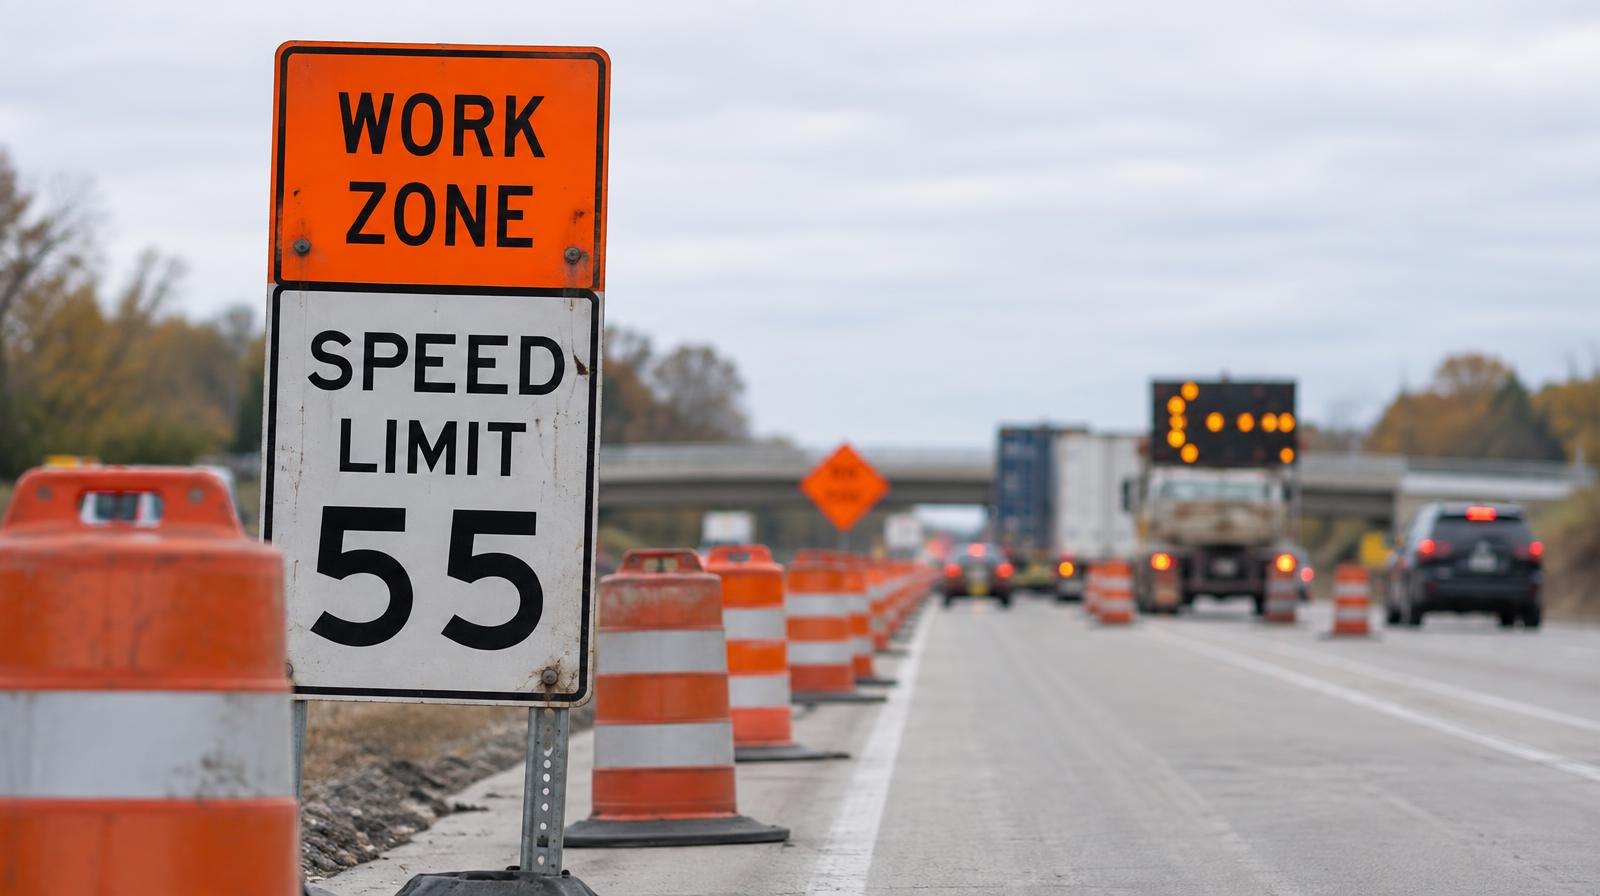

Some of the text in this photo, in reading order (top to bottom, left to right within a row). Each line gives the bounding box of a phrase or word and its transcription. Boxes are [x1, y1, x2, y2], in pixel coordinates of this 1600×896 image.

[338, 91, 546, 158] WORK
[346, 181, 534, 248] ZONE
[308, 330, 566, 396] SPEED
[339, 418, 527, 477] LIMIT
[309, 506, 544, 651] 55
